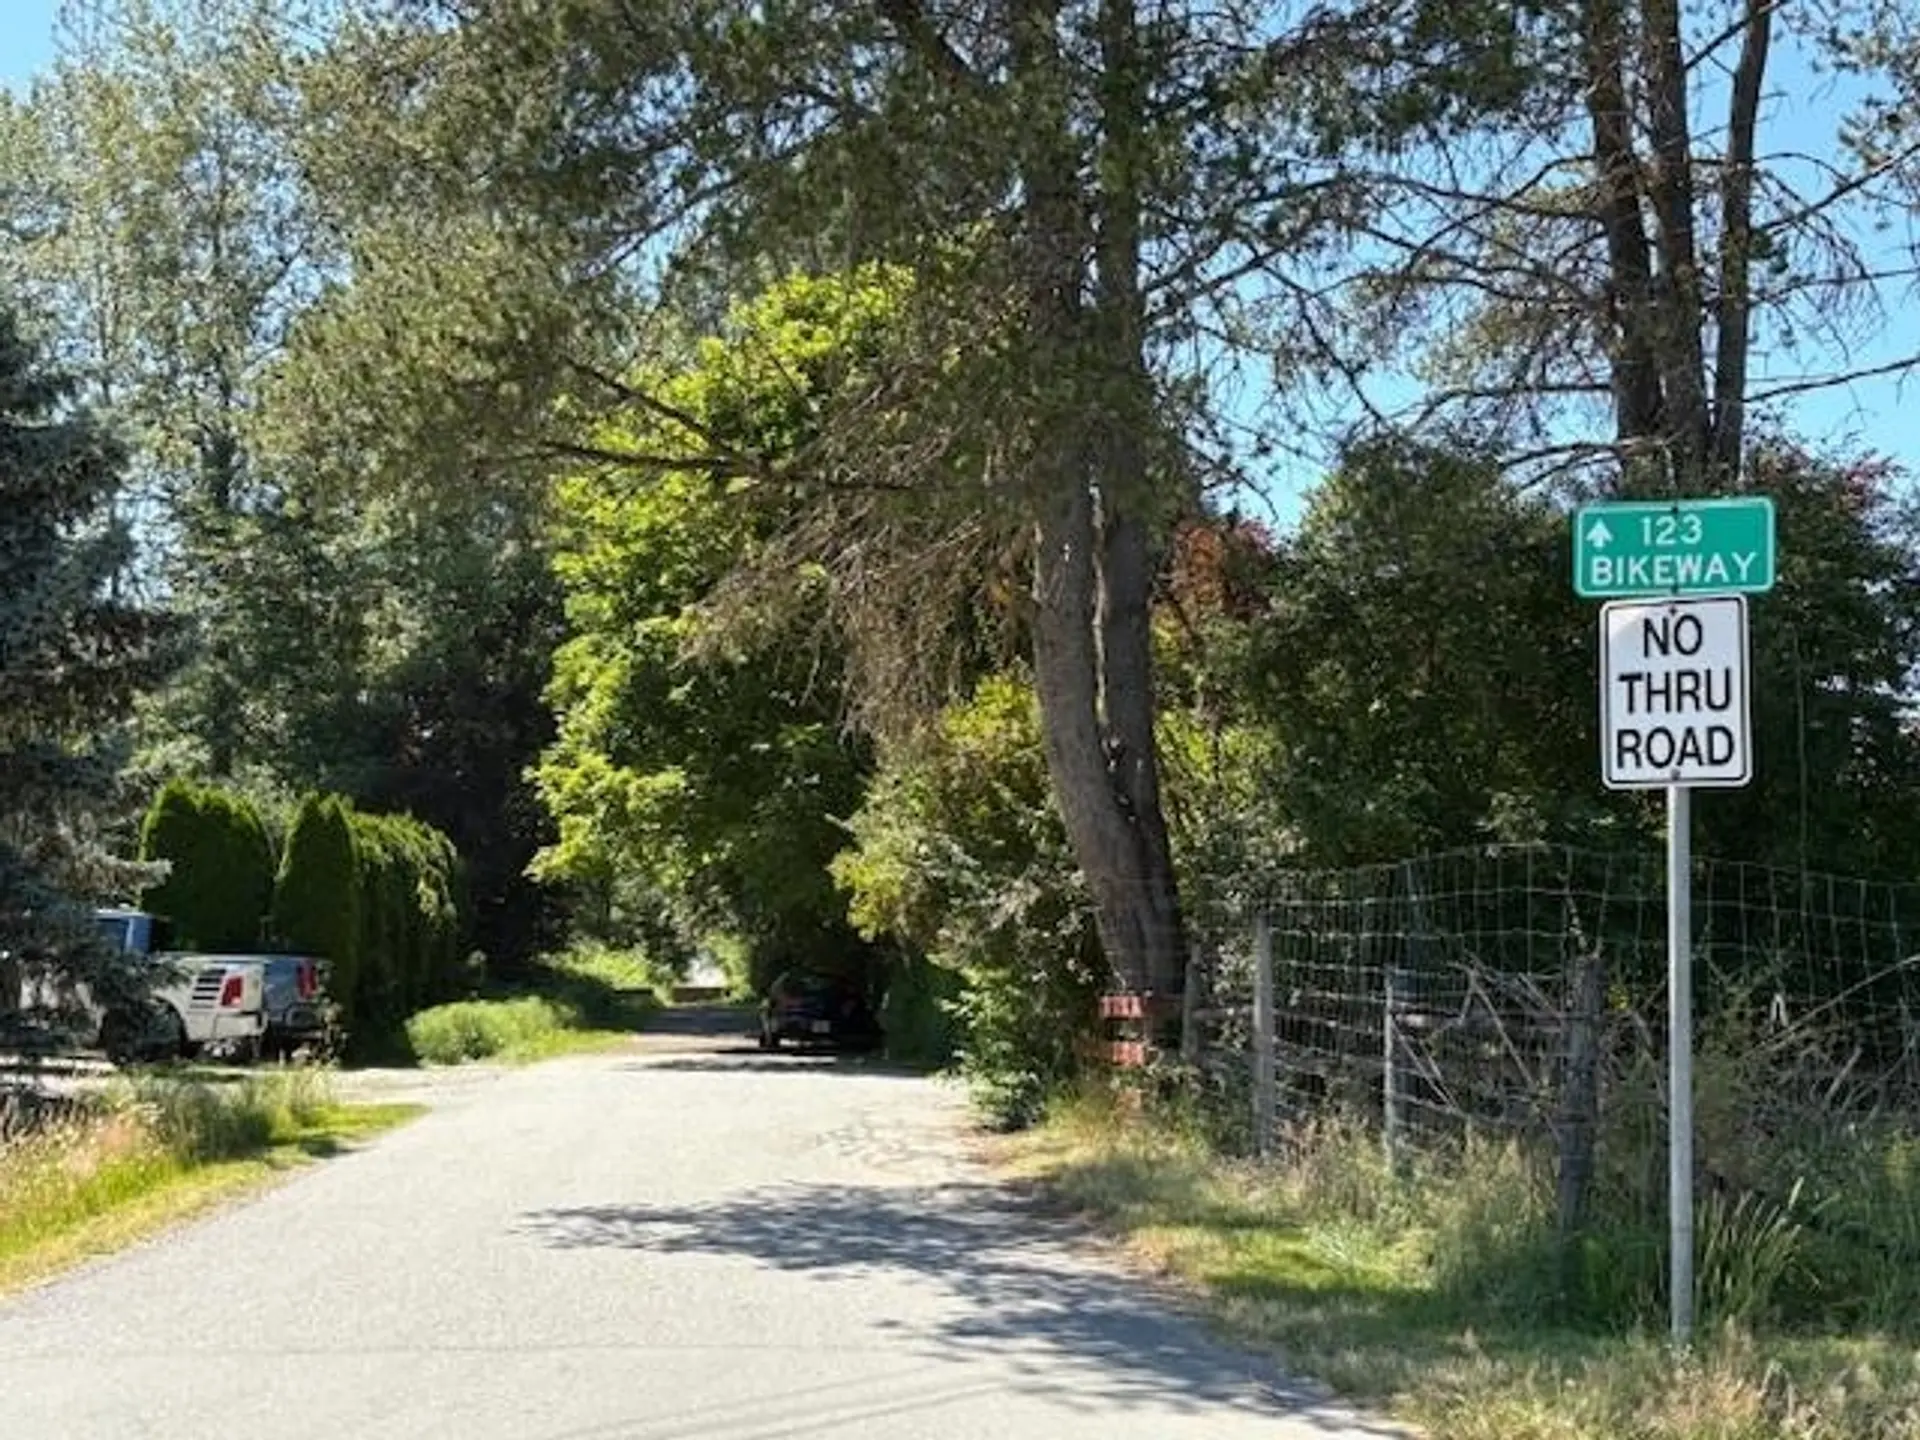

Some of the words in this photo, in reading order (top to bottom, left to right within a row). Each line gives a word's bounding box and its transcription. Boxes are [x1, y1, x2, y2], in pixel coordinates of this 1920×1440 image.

[1642, 514, 1702, 546] 123
[1591, 552, 1758, 586] BIKEWAY
[1643, 614, 1702, 658] NO
[1618, 667, 1732, 714] THRU
[1617, 725, 1734, 769] ROAD
